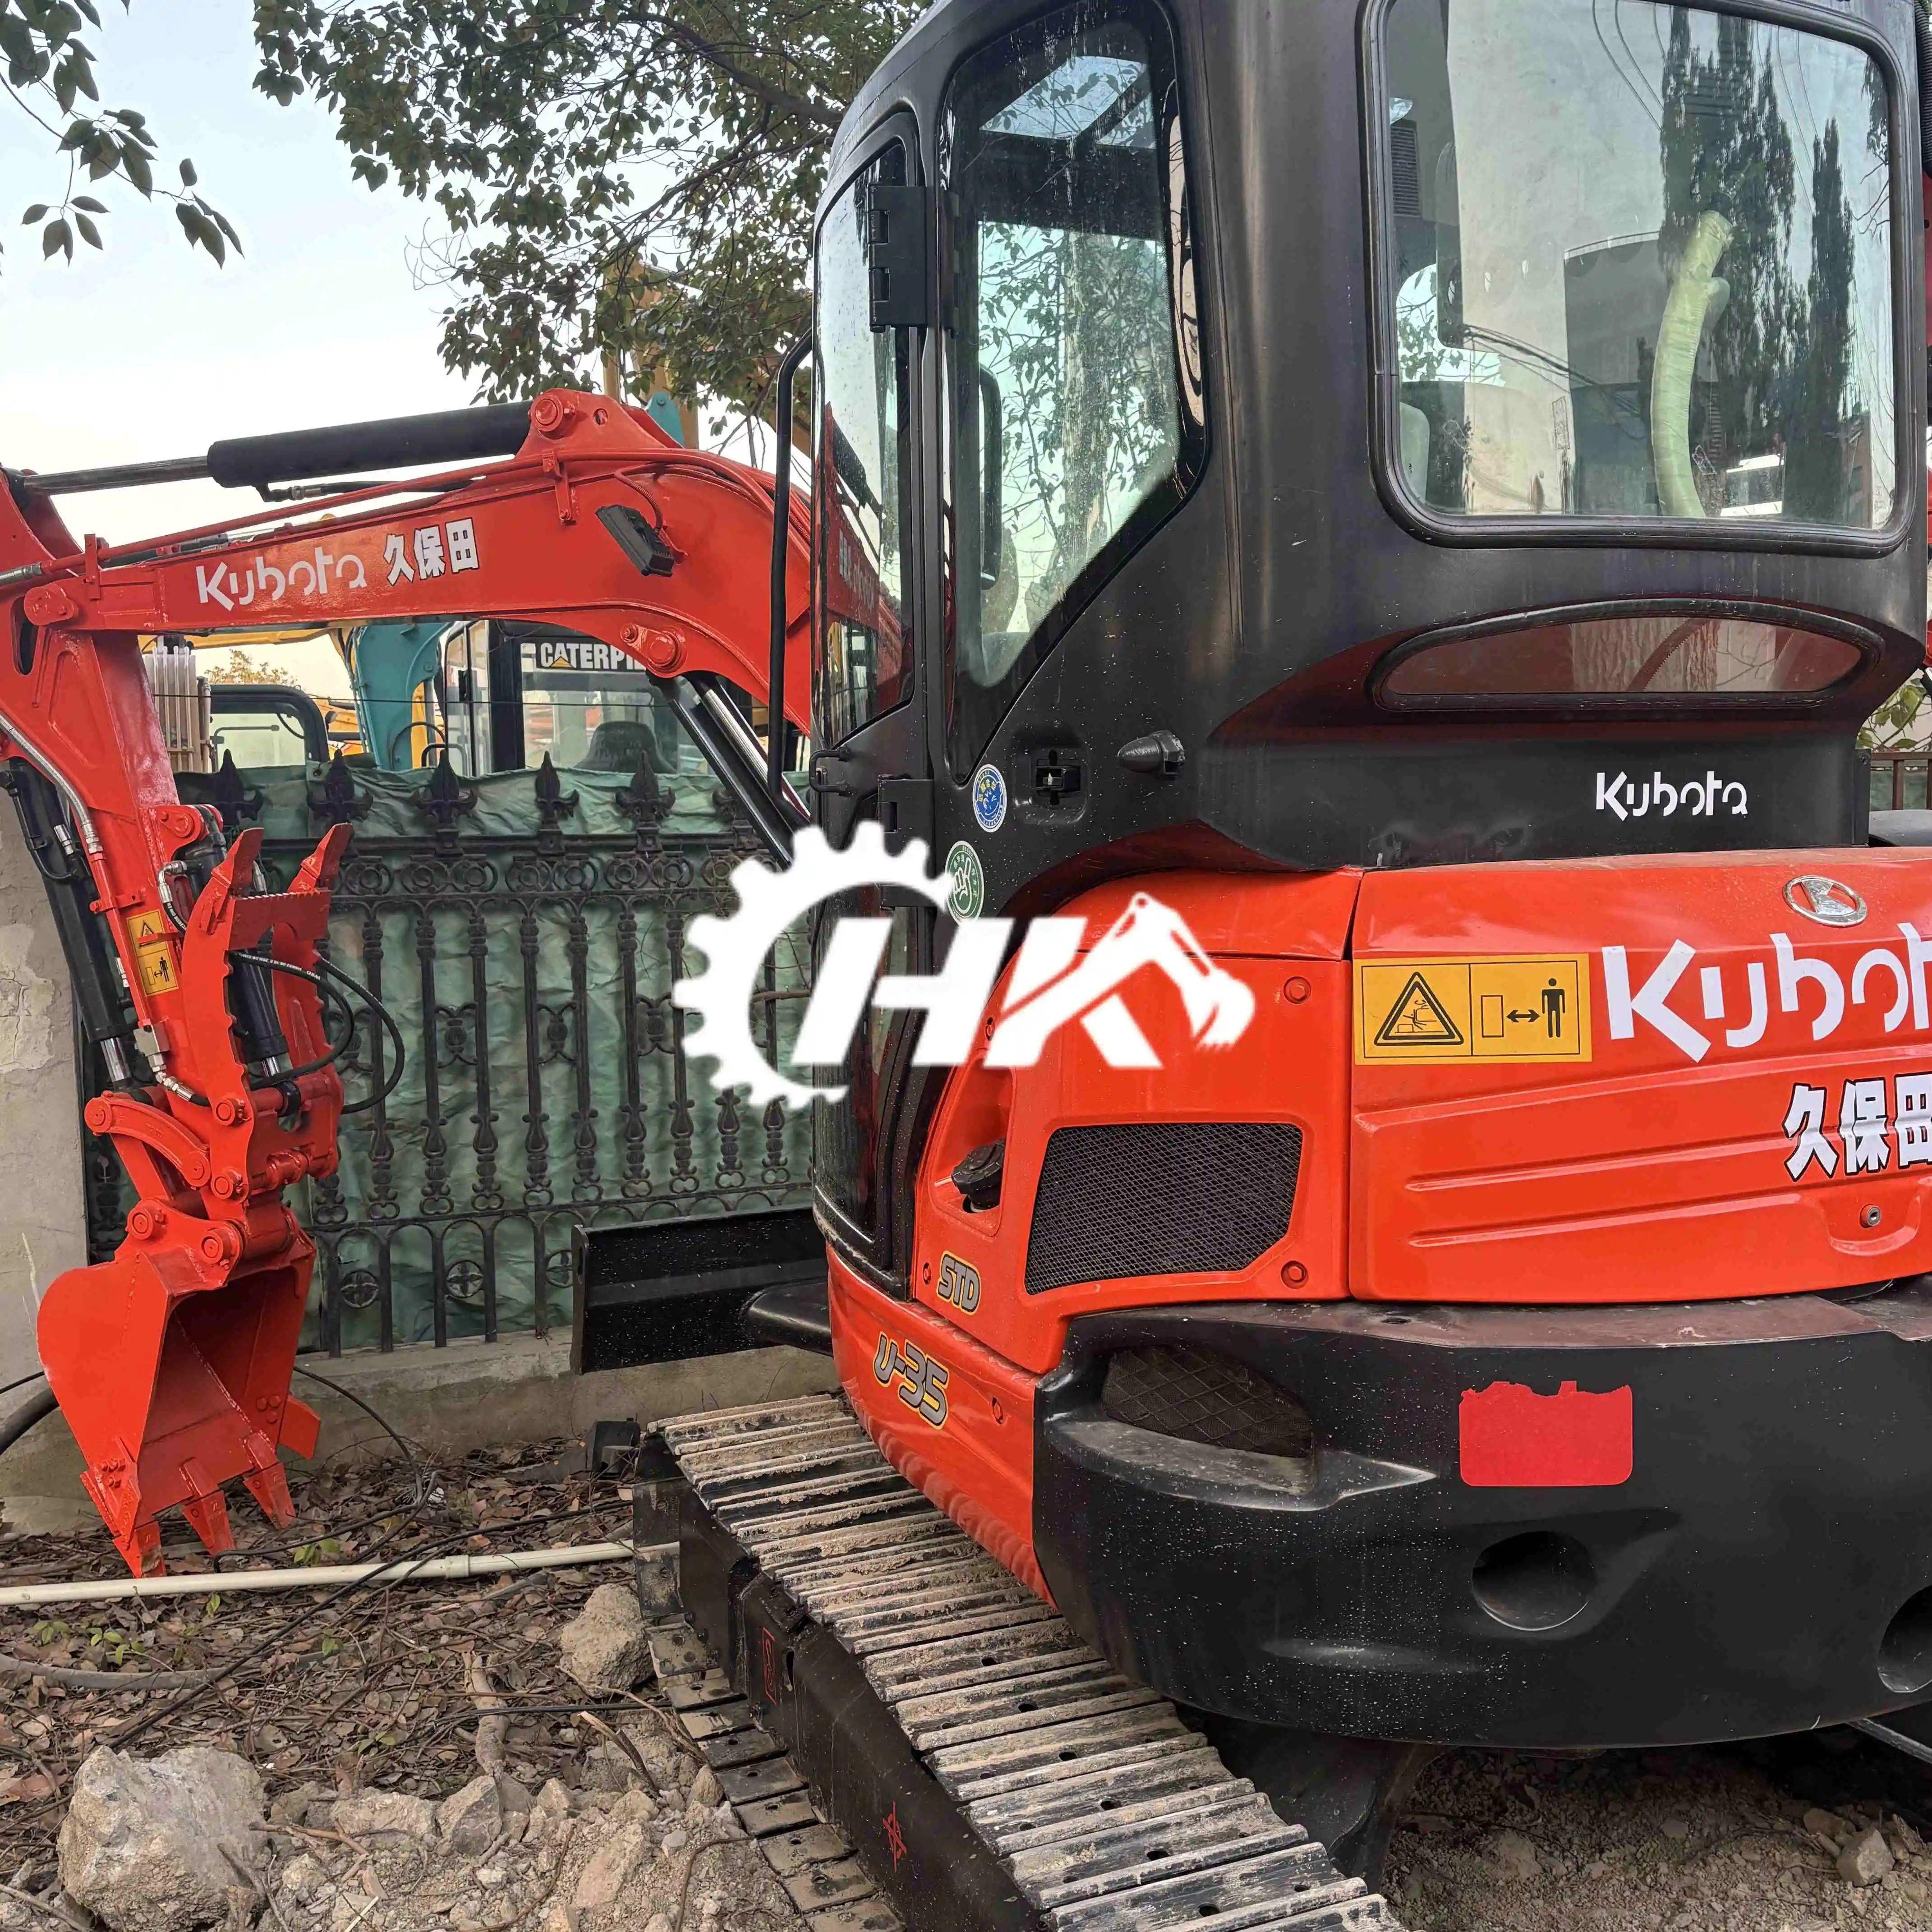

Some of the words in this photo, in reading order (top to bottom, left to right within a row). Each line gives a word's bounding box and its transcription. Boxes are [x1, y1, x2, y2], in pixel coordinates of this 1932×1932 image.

[196, 547, 367, 611] Kubota
[383, 517, 479, 586] 久保田
[1596, 770, 1748, 822] Kubota
[936, 1250, 981, 1315] STD
[873, 1331, 949, 1430] U-35
